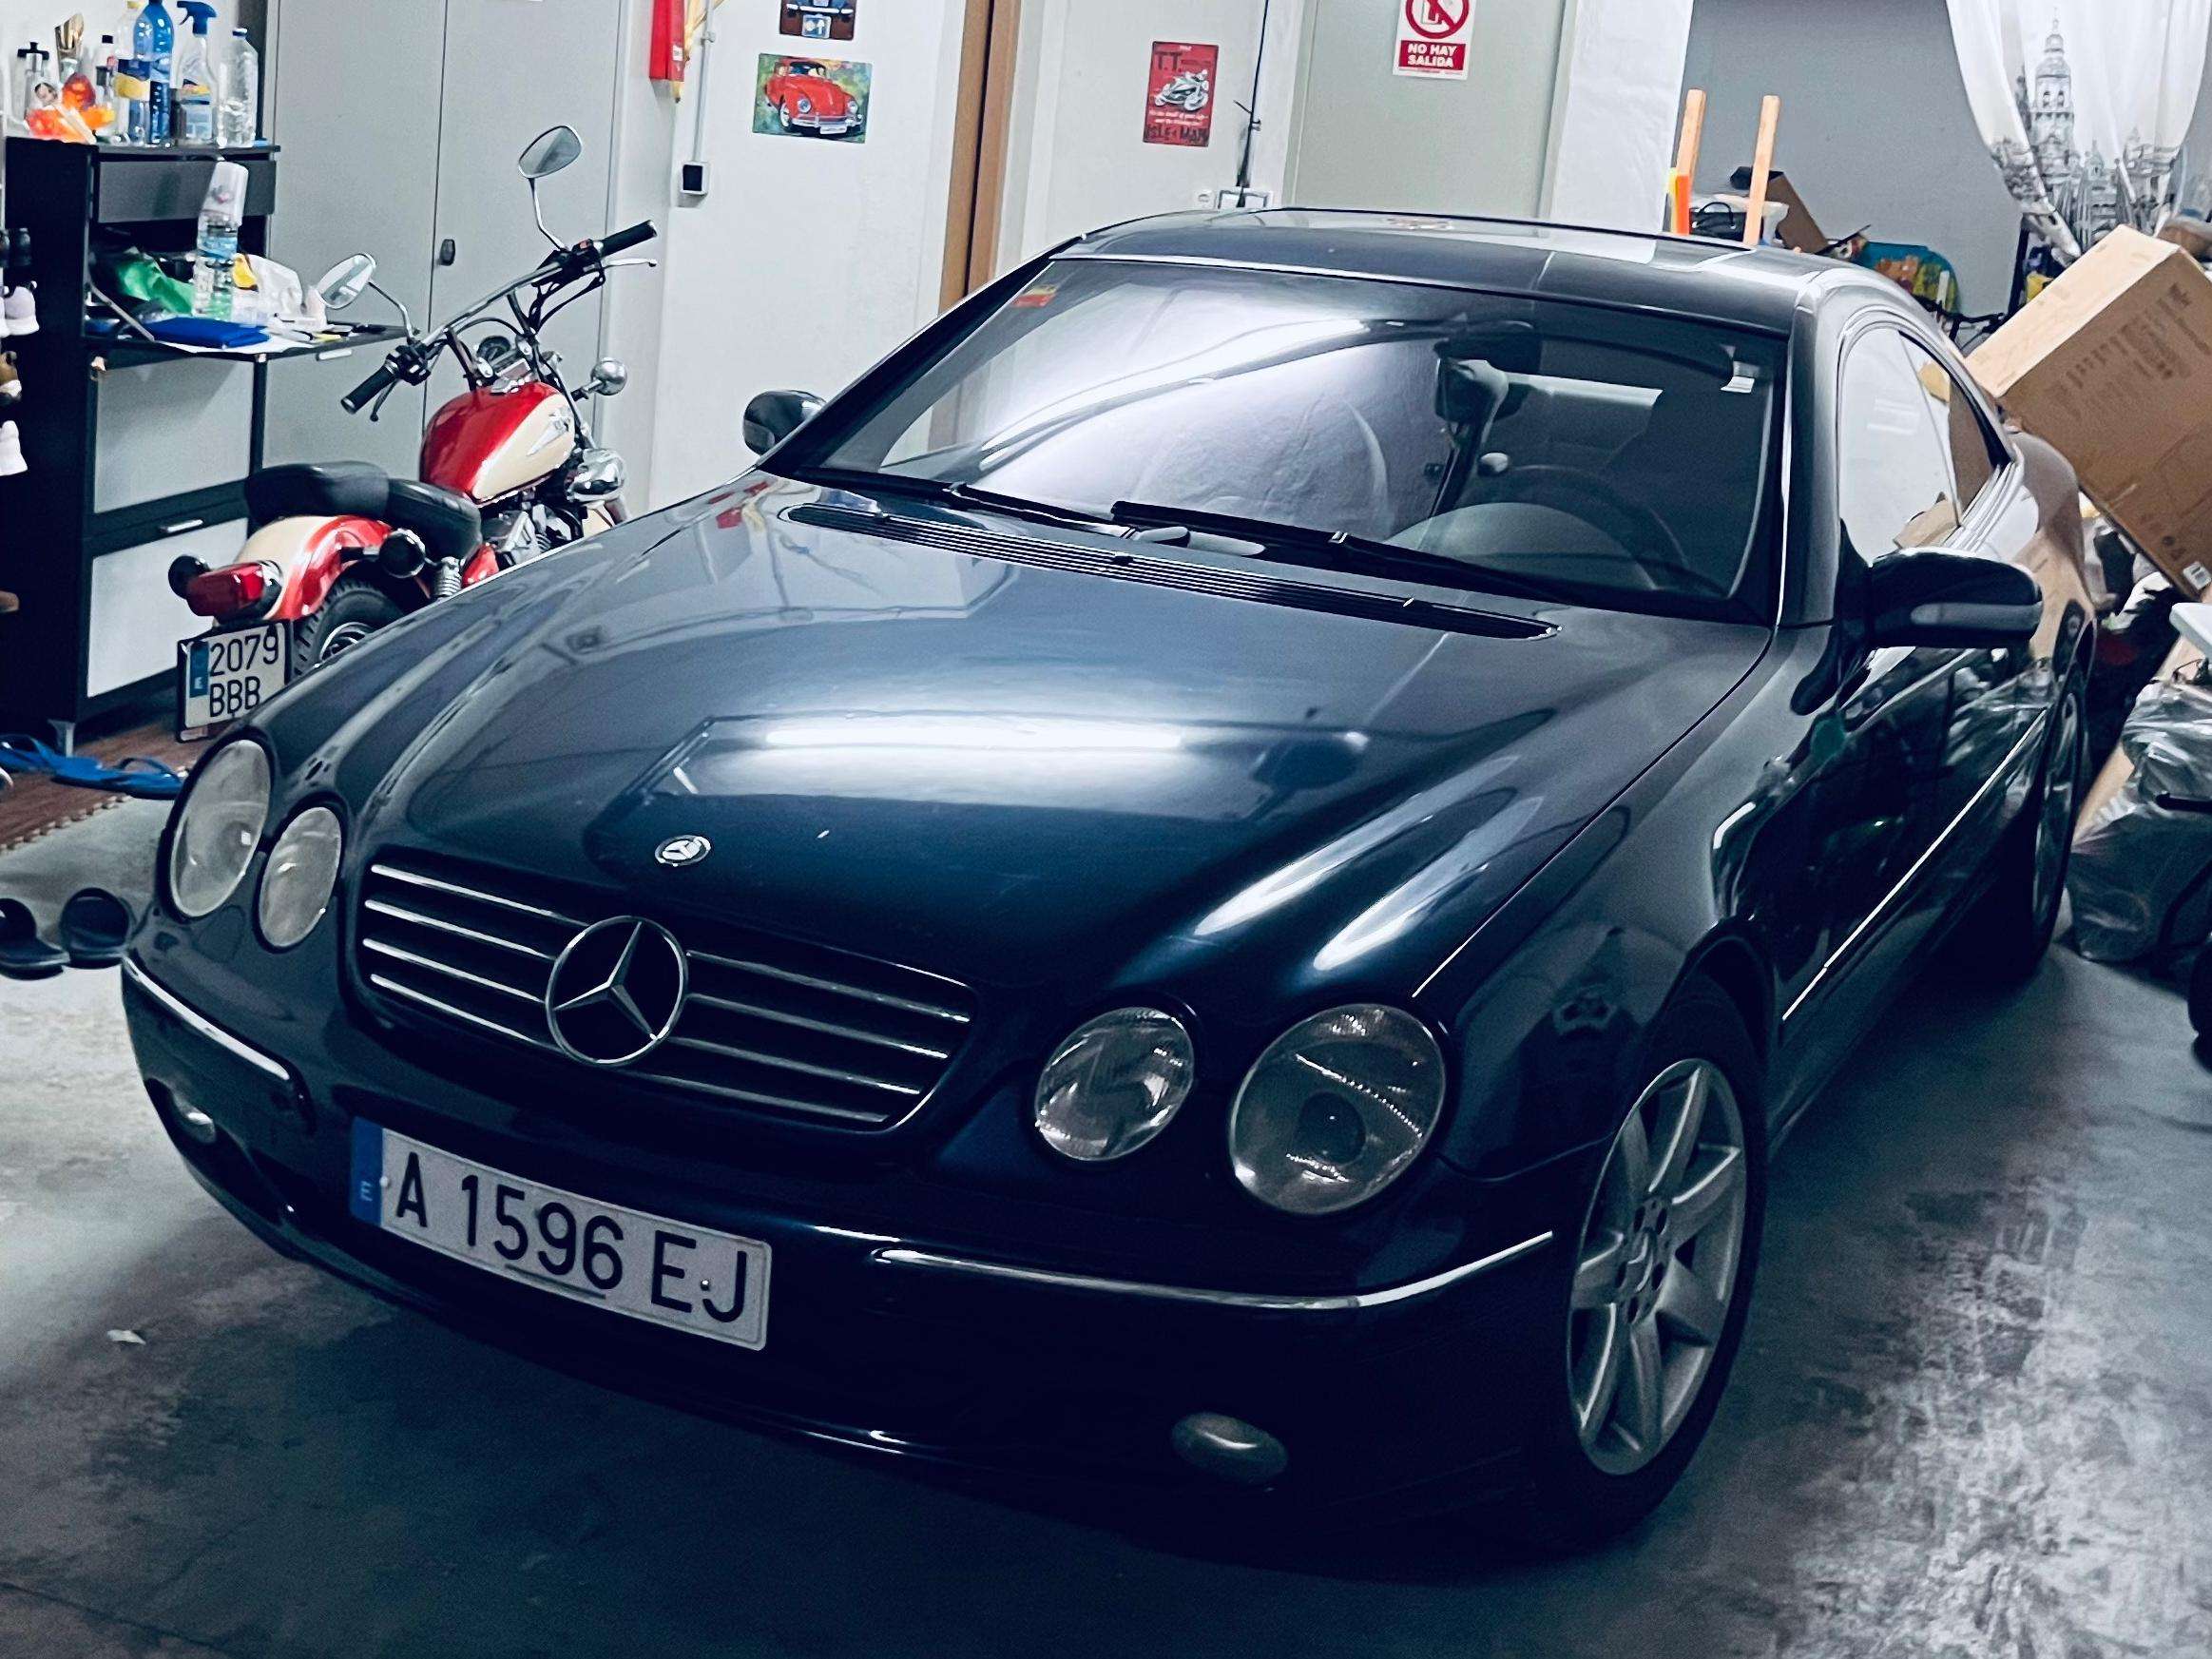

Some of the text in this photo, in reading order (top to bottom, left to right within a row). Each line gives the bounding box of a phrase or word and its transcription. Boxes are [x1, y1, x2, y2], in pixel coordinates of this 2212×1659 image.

[1407, 54, 1454, 68] SALIDA
[1408, 43, 1457, 57] NO HAY
[210, 627, 279, 677] 2079
[210, 675, 260, 717] BBB
[359, 1181, 372, 1202] E
[395, 1150, 748, 1323] A 1596 EJ
